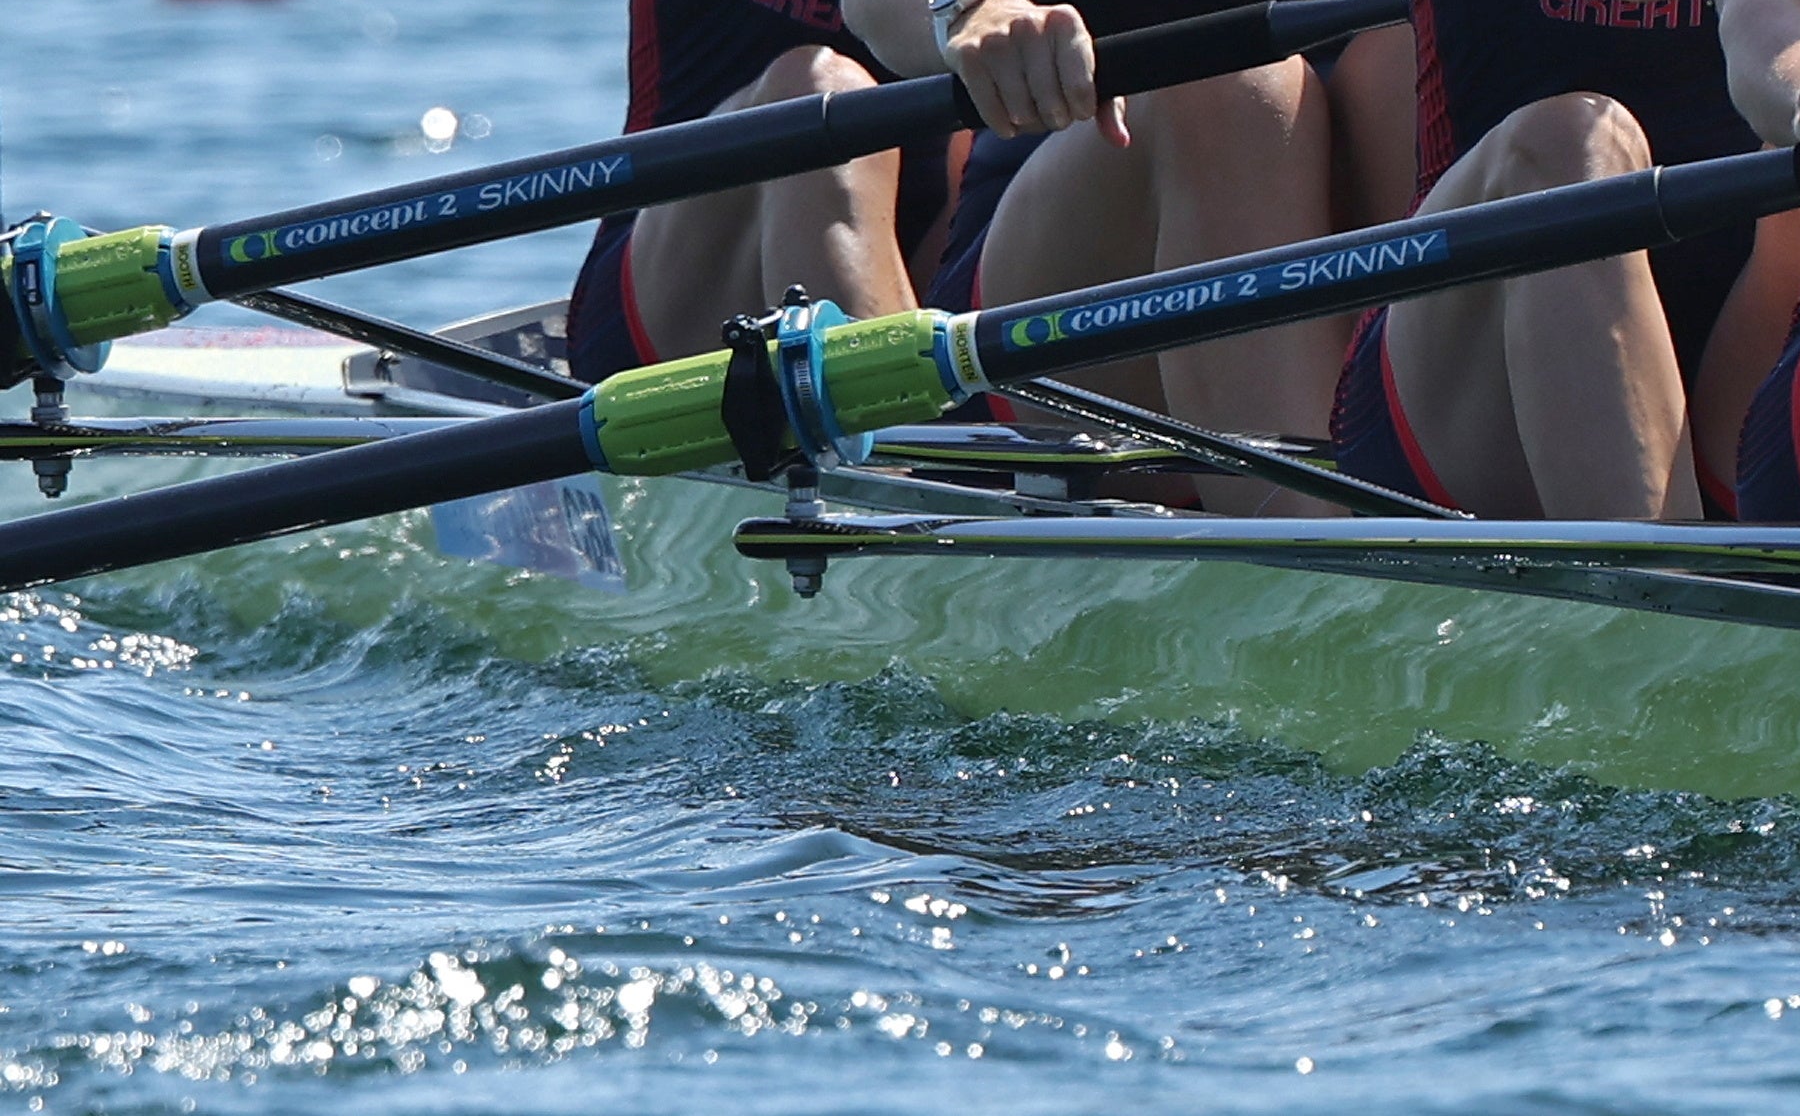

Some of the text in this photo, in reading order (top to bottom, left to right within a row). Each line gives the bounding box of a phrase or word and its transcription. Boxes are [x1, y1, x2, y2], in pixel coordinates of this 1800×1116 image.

[285, 157, 623, 249] concept 2 SKINNY
[1071, 234, 1438, 332] concept 2 SKINNY
